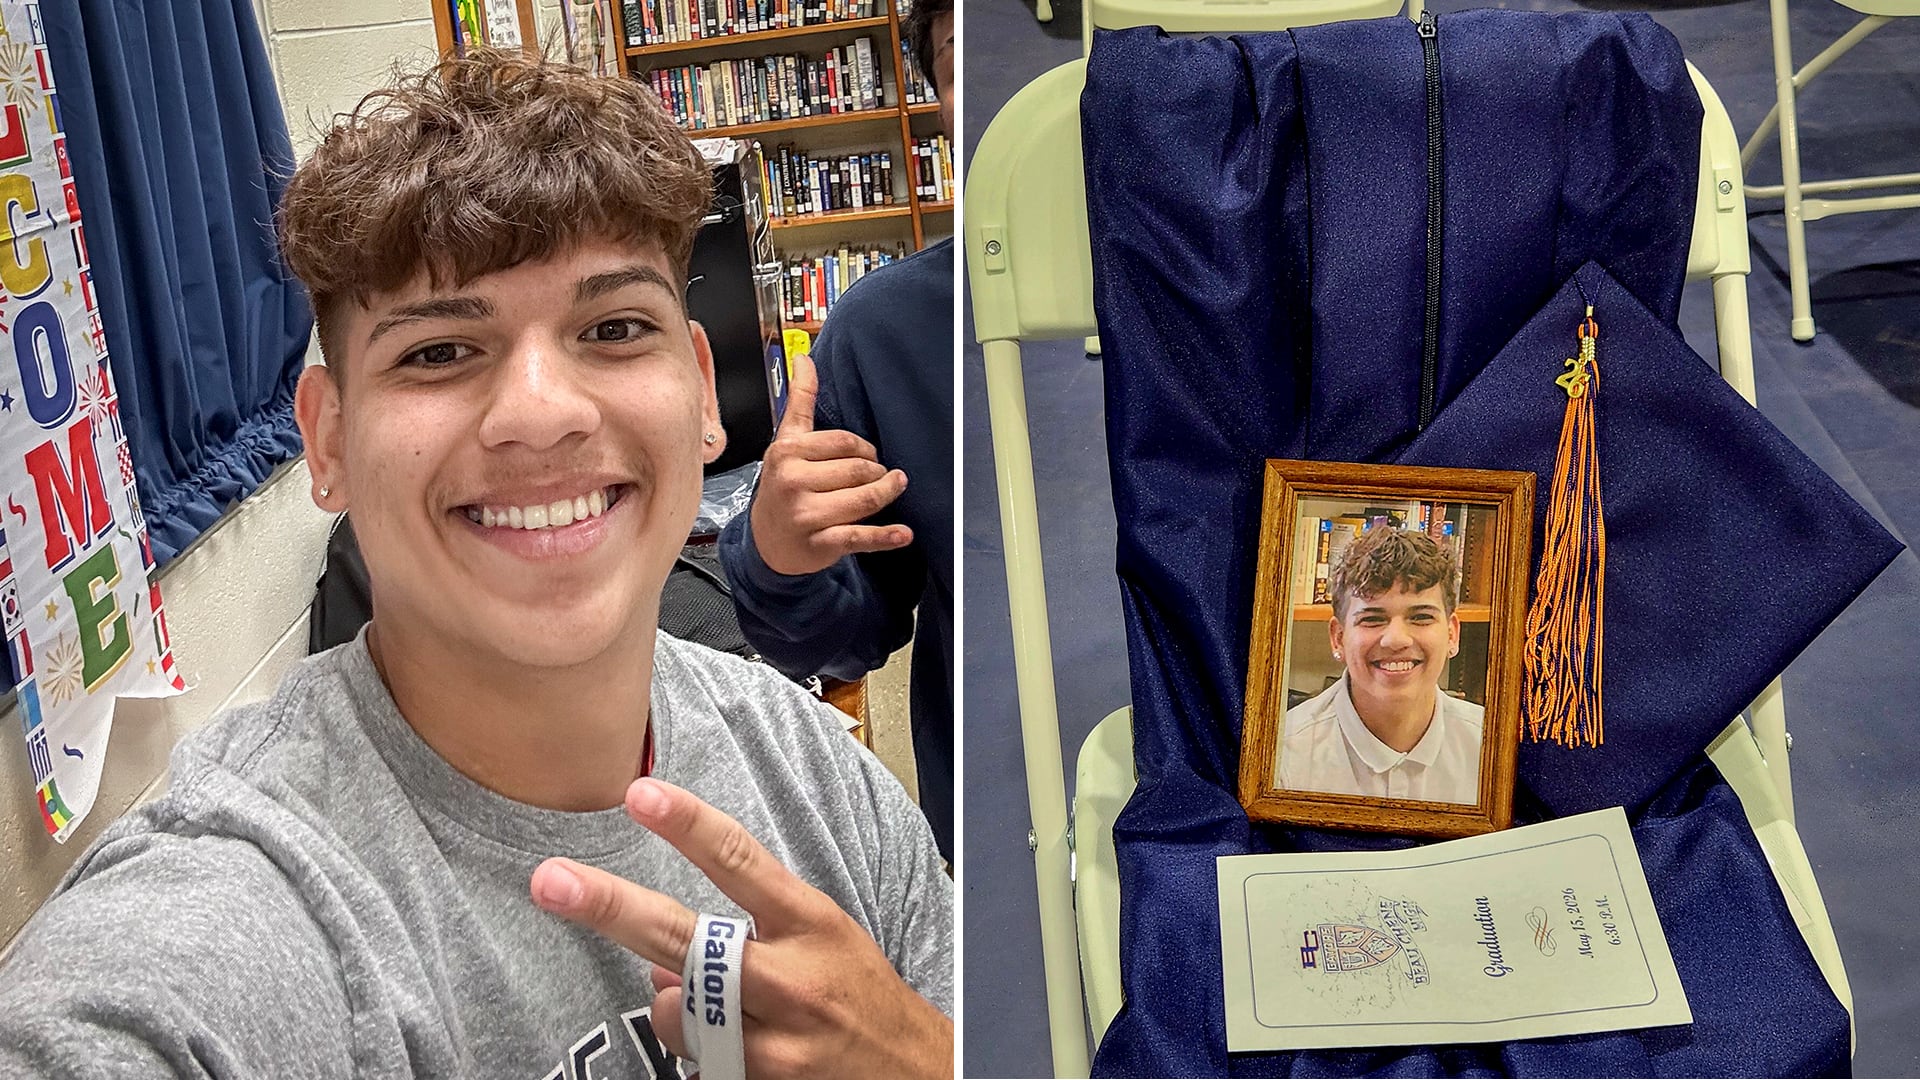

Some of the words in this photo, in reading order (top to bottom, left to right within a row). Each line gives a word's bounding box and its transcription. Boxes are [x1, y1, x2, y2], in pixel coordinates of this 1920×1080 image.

[1555, 358, 1591, 398] 26
[1402, 899, 1422, 931] HIGH
[1561, 887, 1580, 914] 2026
[1595, 895, 1614, 919] P.M.
[1380, 900, 1412, 945] CHENE
[1473, 895, 1514, 977] Graduation
[1570, 915, 1585, 931] 15,
[1602, 922, 1622, 946] 6:30
[1578, 933, 1594, 959] May
[703, 920, 735, 1027] Gators
[1407, 948, 1429, 984] BEAU
